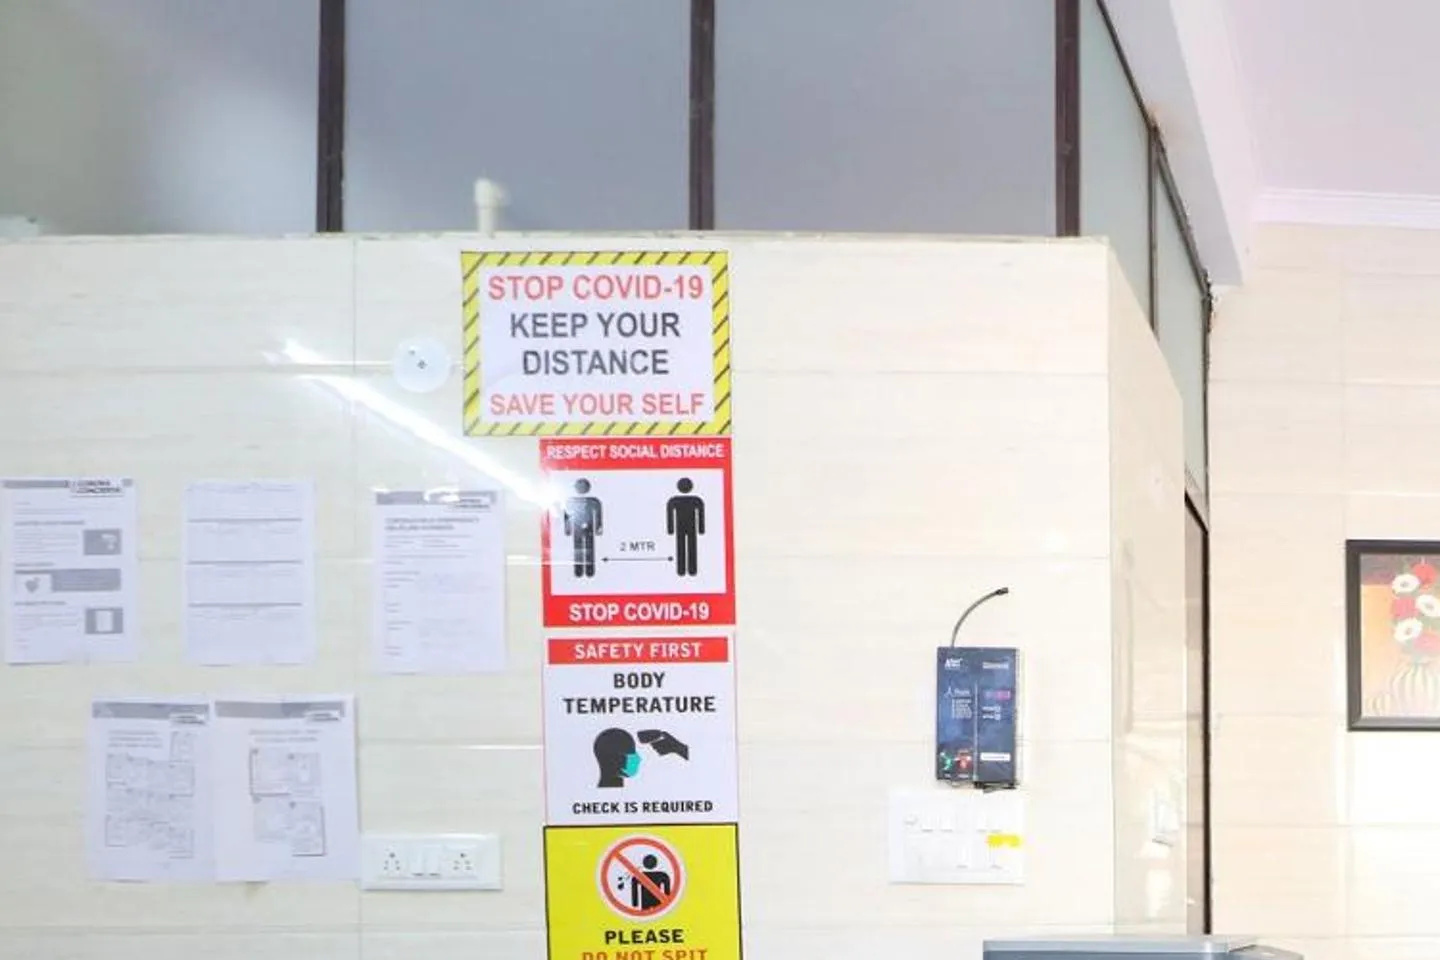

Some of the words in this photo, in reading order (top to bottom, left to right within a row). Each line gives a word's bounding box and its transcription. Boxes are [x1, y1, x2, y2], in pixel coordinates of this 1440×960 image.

[488, 274, 563, 301] STOP
[573, 274, 704, 301] COVID-19
[510, 312, 587, 338] KEEP
[597, 311, 680, 338] YOUR
[522, 349, 669, 376] DISTANCE
[490, 393, 554, 416] SAVE
[563, 393, 633, 416] YOUR
[641, 392, 704, 415] SELF
[547, 444, 605, 460] RESPECT
[610, 444, 656, 459] SOCIAL
[661, 443, 725, 458] DISTANCE
[619, 541, 626, 551] 2
[630, 541, 656, 551] MTR
[569, 604, 619, 621] STOP
[624, 602, 710, 620] COVID-19
[575, 643, 647, 659] SAFETY
[651, 643, 702, 658] FIRST
[613, 673, 665, 689] BODY
[563, 696, 716, 714] TEMPERATURE
[572, 802, 620, 814] CHECK
[624, 802, 638, 814] IS
[642, 801, 713, 813] REQUIRED
[605, 930, 684, 944] PLEASE
